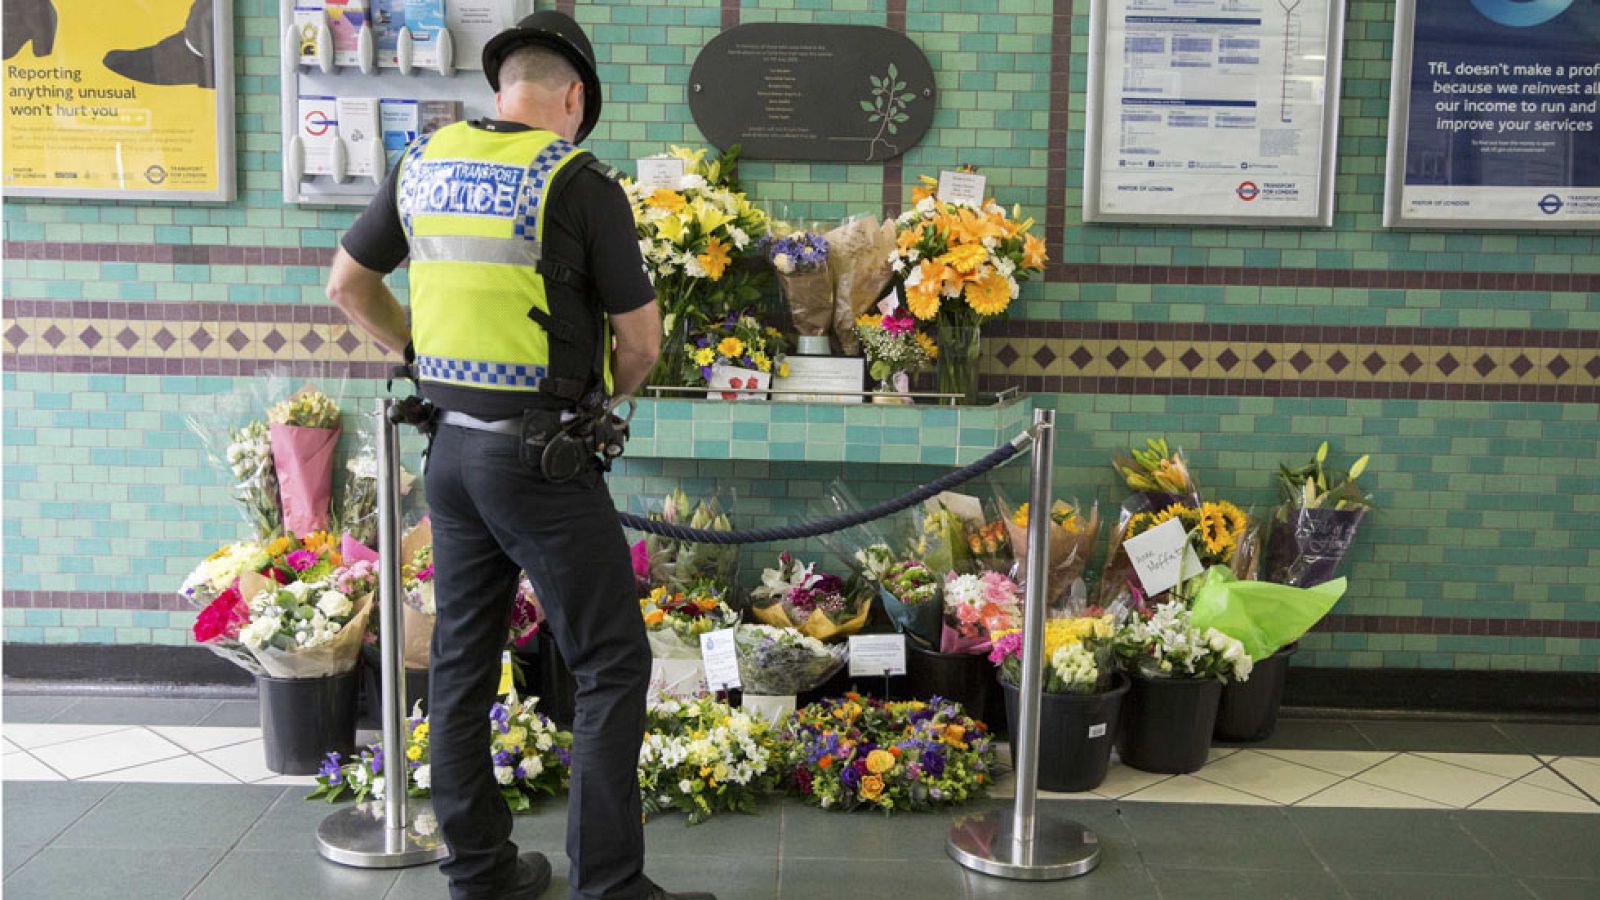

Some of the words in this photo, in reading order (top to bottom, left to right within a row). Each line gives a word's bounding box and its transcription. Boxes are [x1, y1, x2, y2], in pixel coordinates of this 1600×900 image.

[8, 66, 82, 81] Reporting
[1428, 61, 1450, 75] TfL
[1455, 62, 1509, 76] doesn't
[1513, 63, 1551, 76] make
[1556, 67, 1564, 76] a
[9, 86, 73, 100] anything
[78, 85, 136, 99] unusual
[1433, 80, 1493, 94] because
[1497, 84, 1518, 94] we
[1522, 82, 1580, 95] reinvest
[10, 104, 52, 116] won't
[56, 104, 88, 117] hurt
[92, 107, 119, 121] you
[1435, 101, 1460, 112] our
[1464, 99, 1516, 112] income
[1521, 101, 1536, 112] to
[1541, 102, 1564, 113] run
[1569, 100, 1596, 114] and
[1437, 117, 1494, 132] improve
[1499, 120, 1530, 133] your
[1534, 118, 1593, 132] services
[454, 164, 520, 184] TRANSPORT
[413, 181, 516, 213] POLICE
